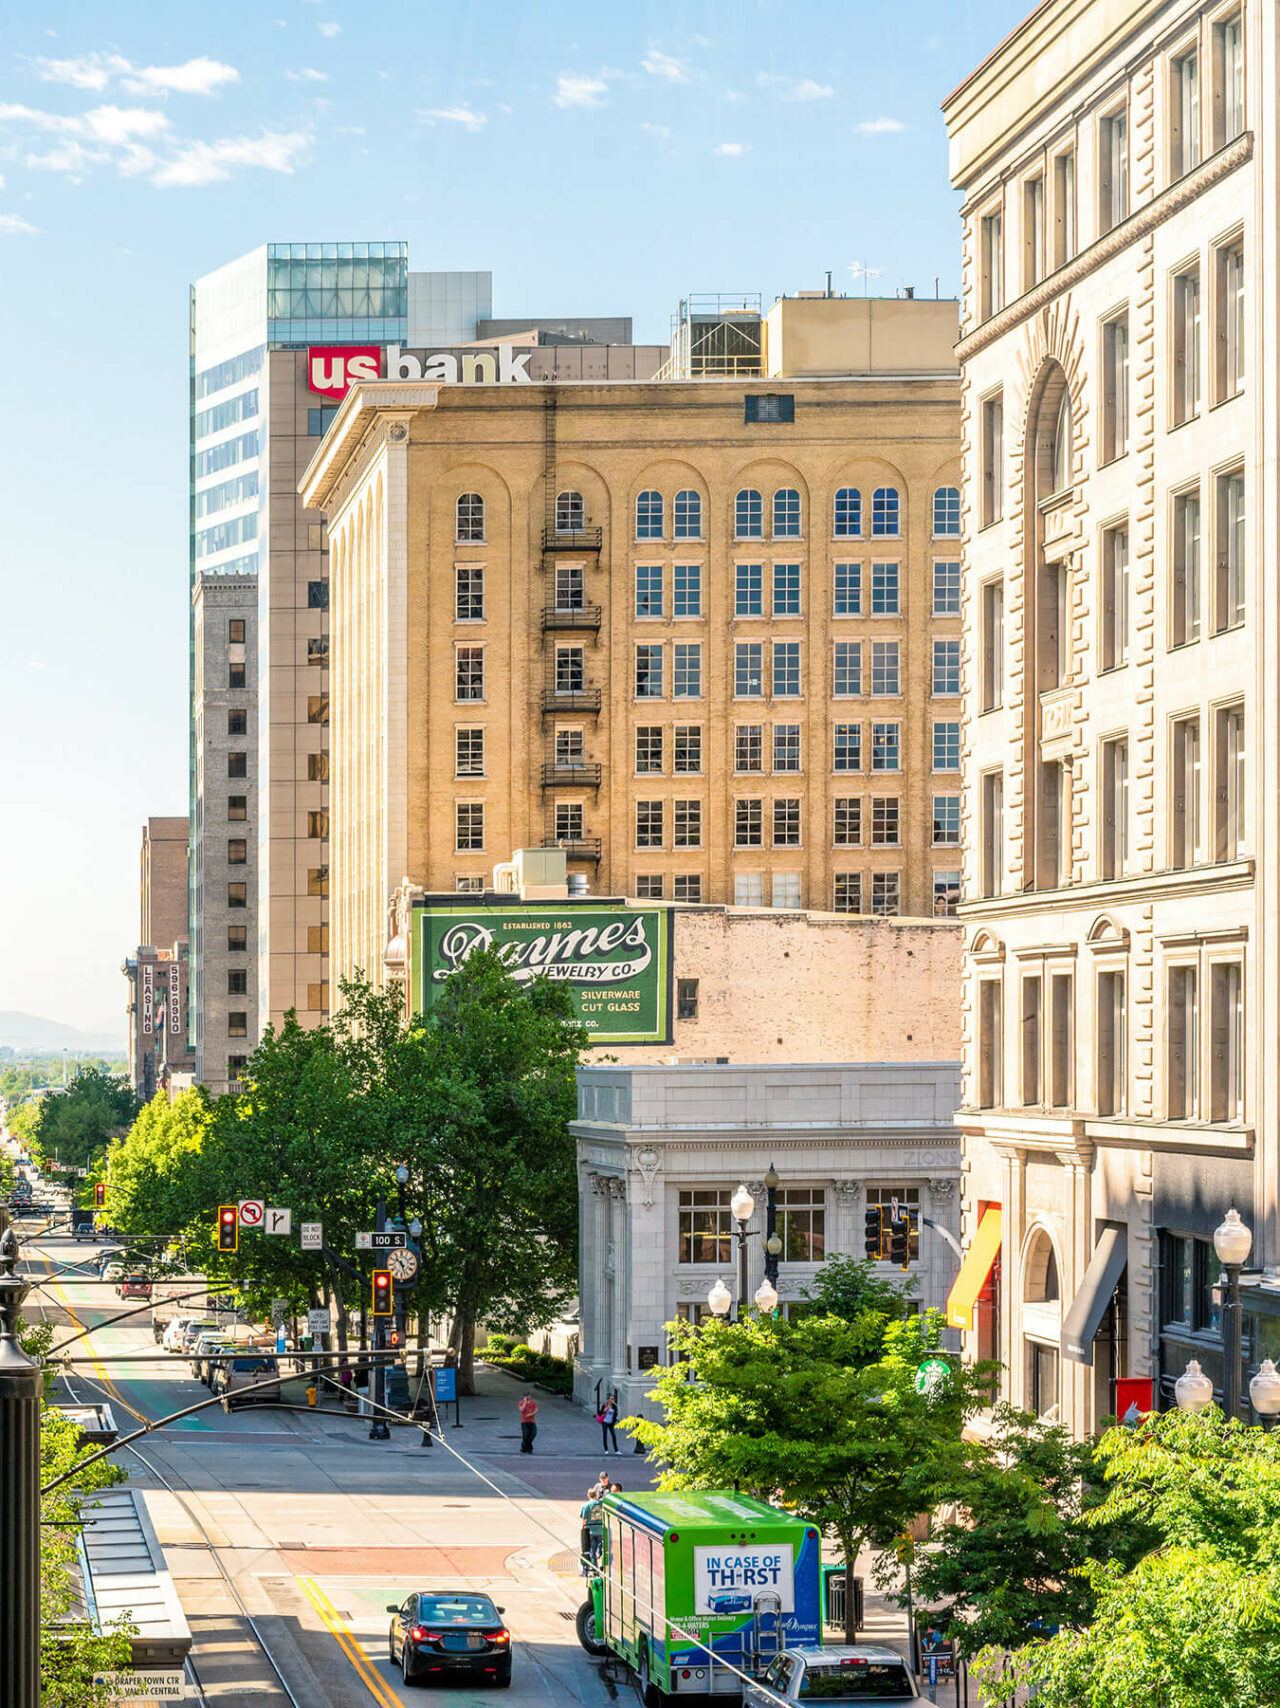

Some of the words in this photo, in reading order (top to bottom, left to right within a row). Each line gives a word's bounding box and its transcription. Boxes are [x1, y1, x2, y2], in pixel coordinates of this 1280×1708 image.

[502, 922, 551, 930] ESTABLISHED
[554, 921, 573, 930] 1862
[541, 965, 608, 978] JEWELRY
[612, 963, 636, 976] CO.
[144, 966, 152, 1033] LEASING
[581, 990, 641, 1000] SILVERWARE
[581, 1003, 603, 1011] CUT
[607, 1002, 641, 1012] GLASS
[904, 1151, 957, 1166] ZIONS
[375, 1236, 391, 1245] 100
[394, 1236, 402, 1245] S.
[707, 1557, 721, 1569] IN
[724, 1556, 760, 1569] CASE
[762, 1556, 781, 1568] OF
[167, 1676, 180, 1684] CTR
[150, 1687, 180, 1695] CENTRAL
